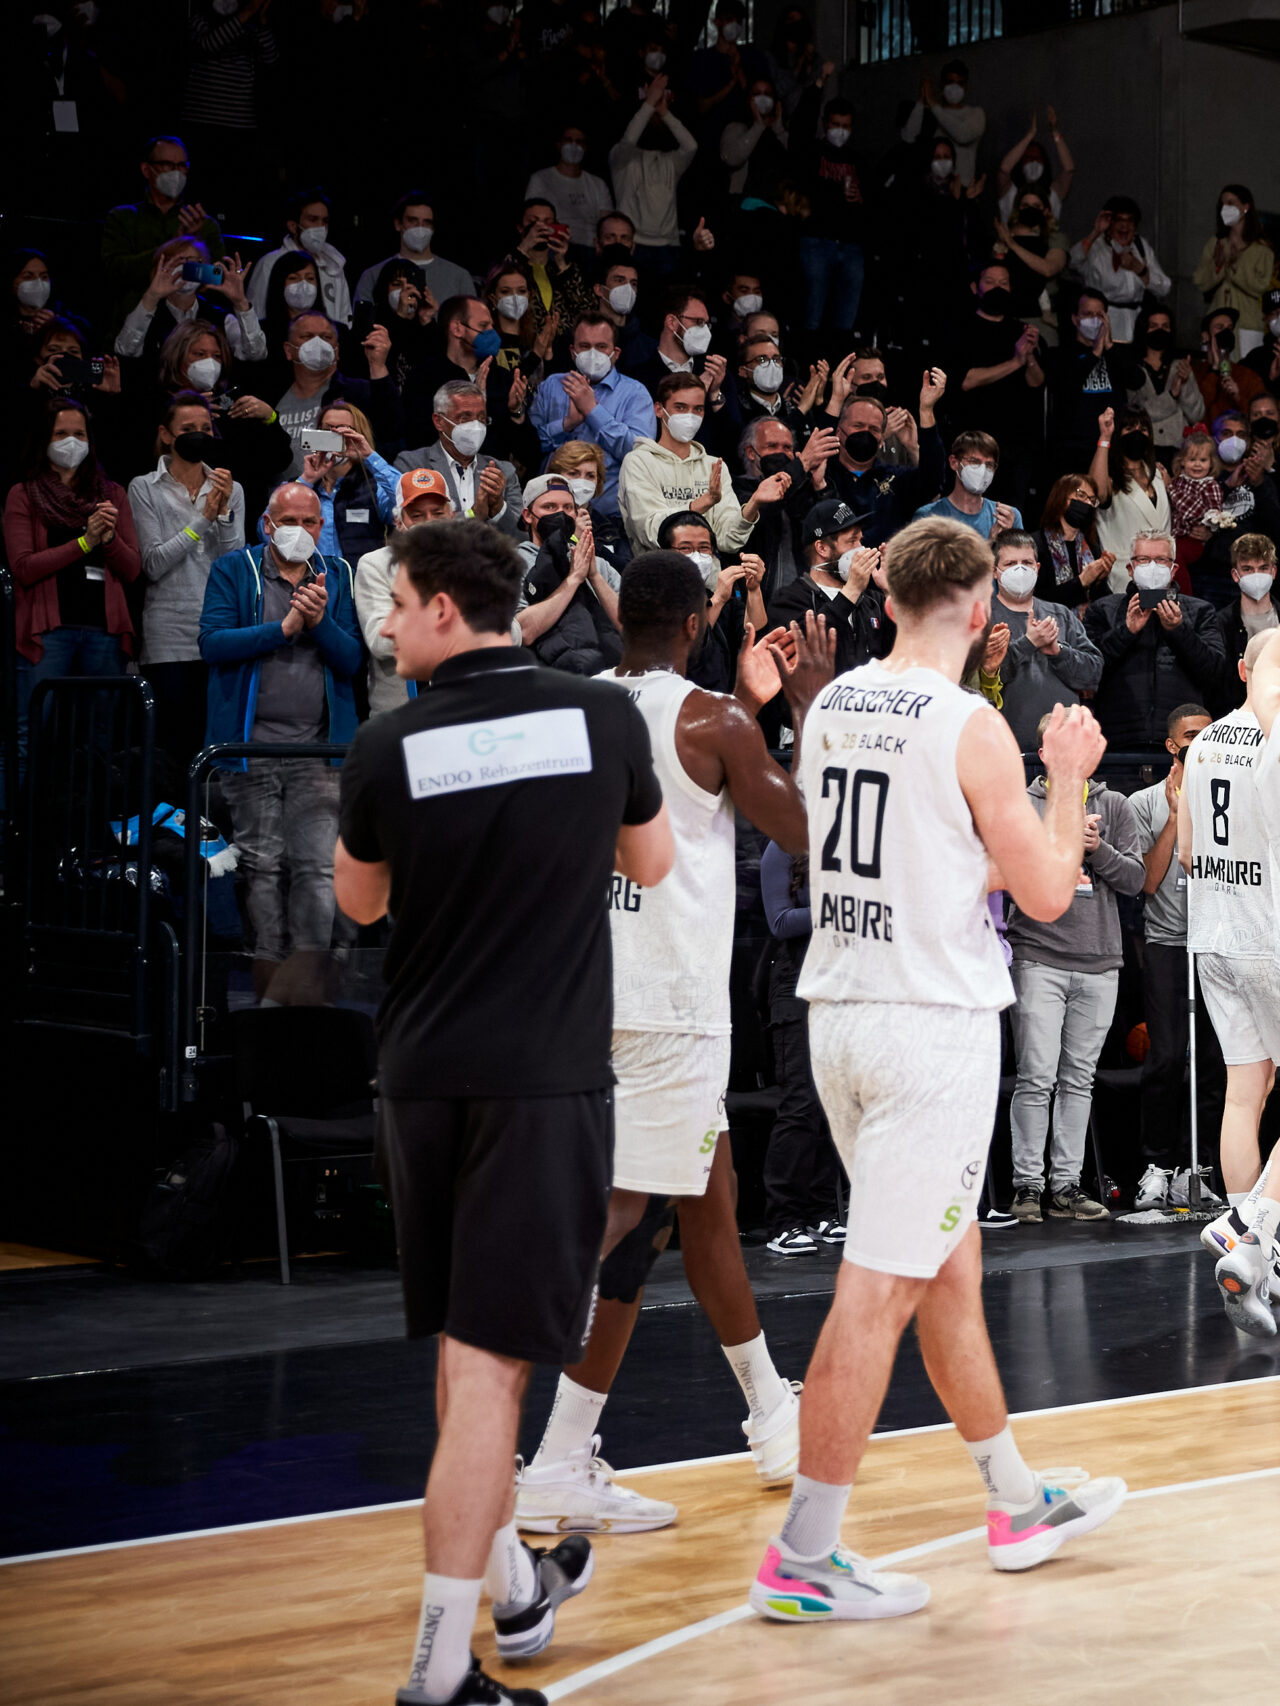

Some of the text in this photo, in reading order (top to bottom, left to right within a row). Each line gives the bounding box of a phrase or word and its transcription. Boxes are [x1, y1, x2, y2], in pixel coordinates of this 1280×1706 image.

[820, 684, 933, 719] DRESCHER
[858, 734, 907, 755] BLACK
[1202, 723, 1264, 747] CHRISTEN
[418, 755, 585, 792] ENDO Rehazentrum
[1224, 754, 1254, 768] BLACK
[820, 766, 890, 879] 20
[1210, 778, 1231, 846] 8
